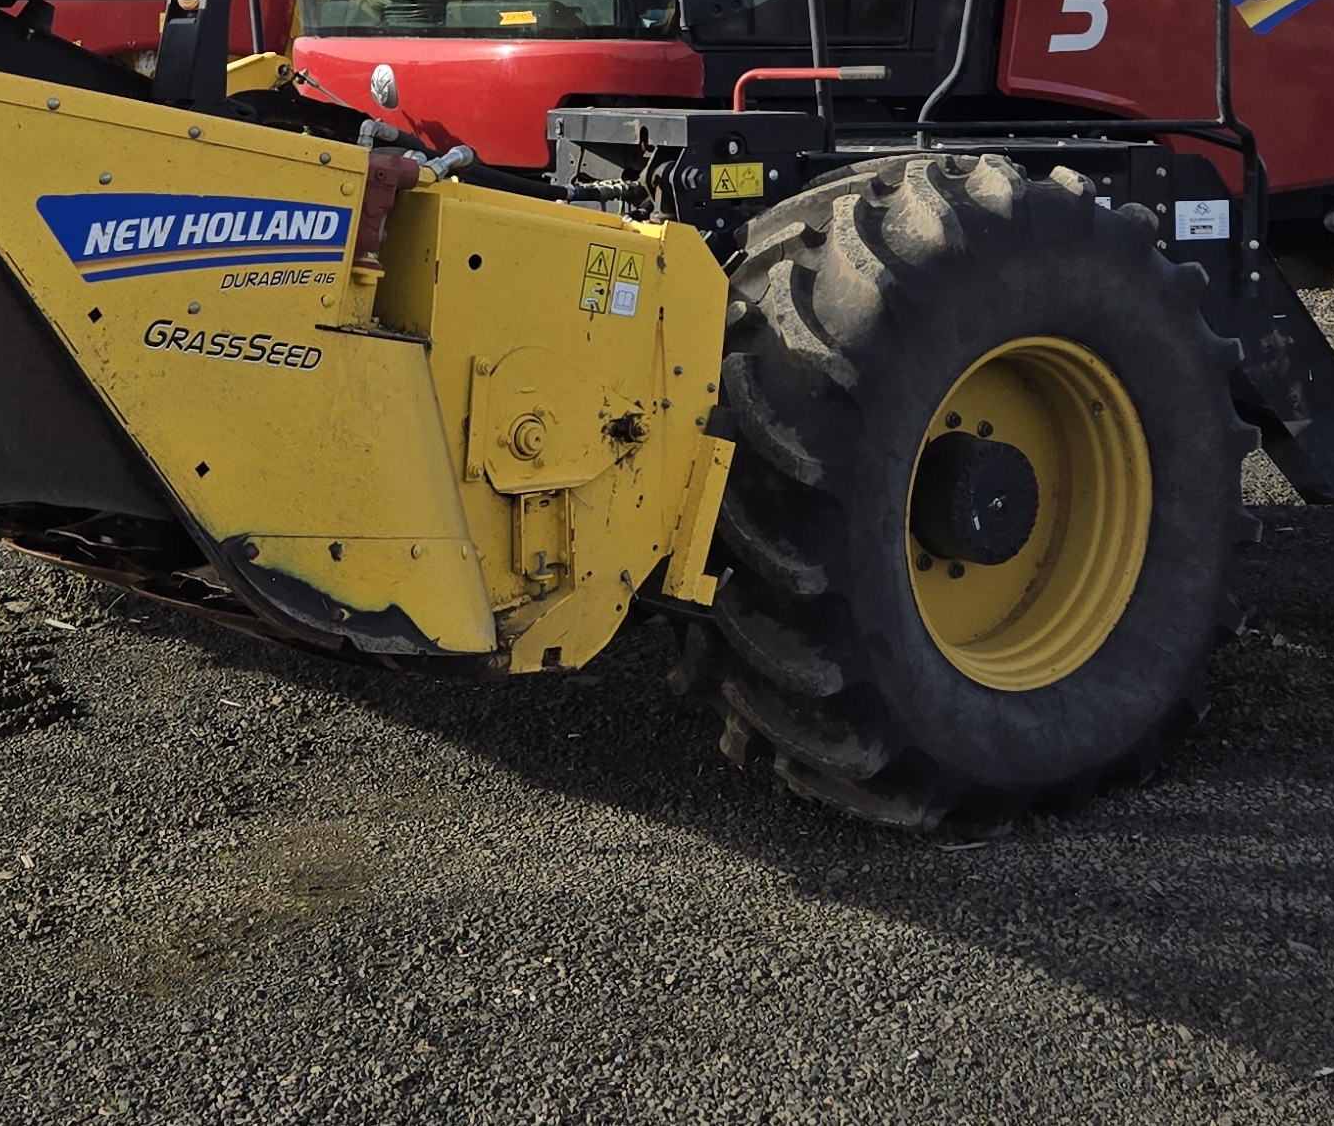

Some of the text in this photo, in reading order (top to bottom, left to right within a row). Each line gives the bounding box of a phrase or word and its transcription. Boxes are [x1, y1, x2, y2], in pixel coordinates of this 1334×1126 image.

[83, 210, 340, 256] NEW HOLLAND
[220, 269, 337, 290] DURABINE 416
